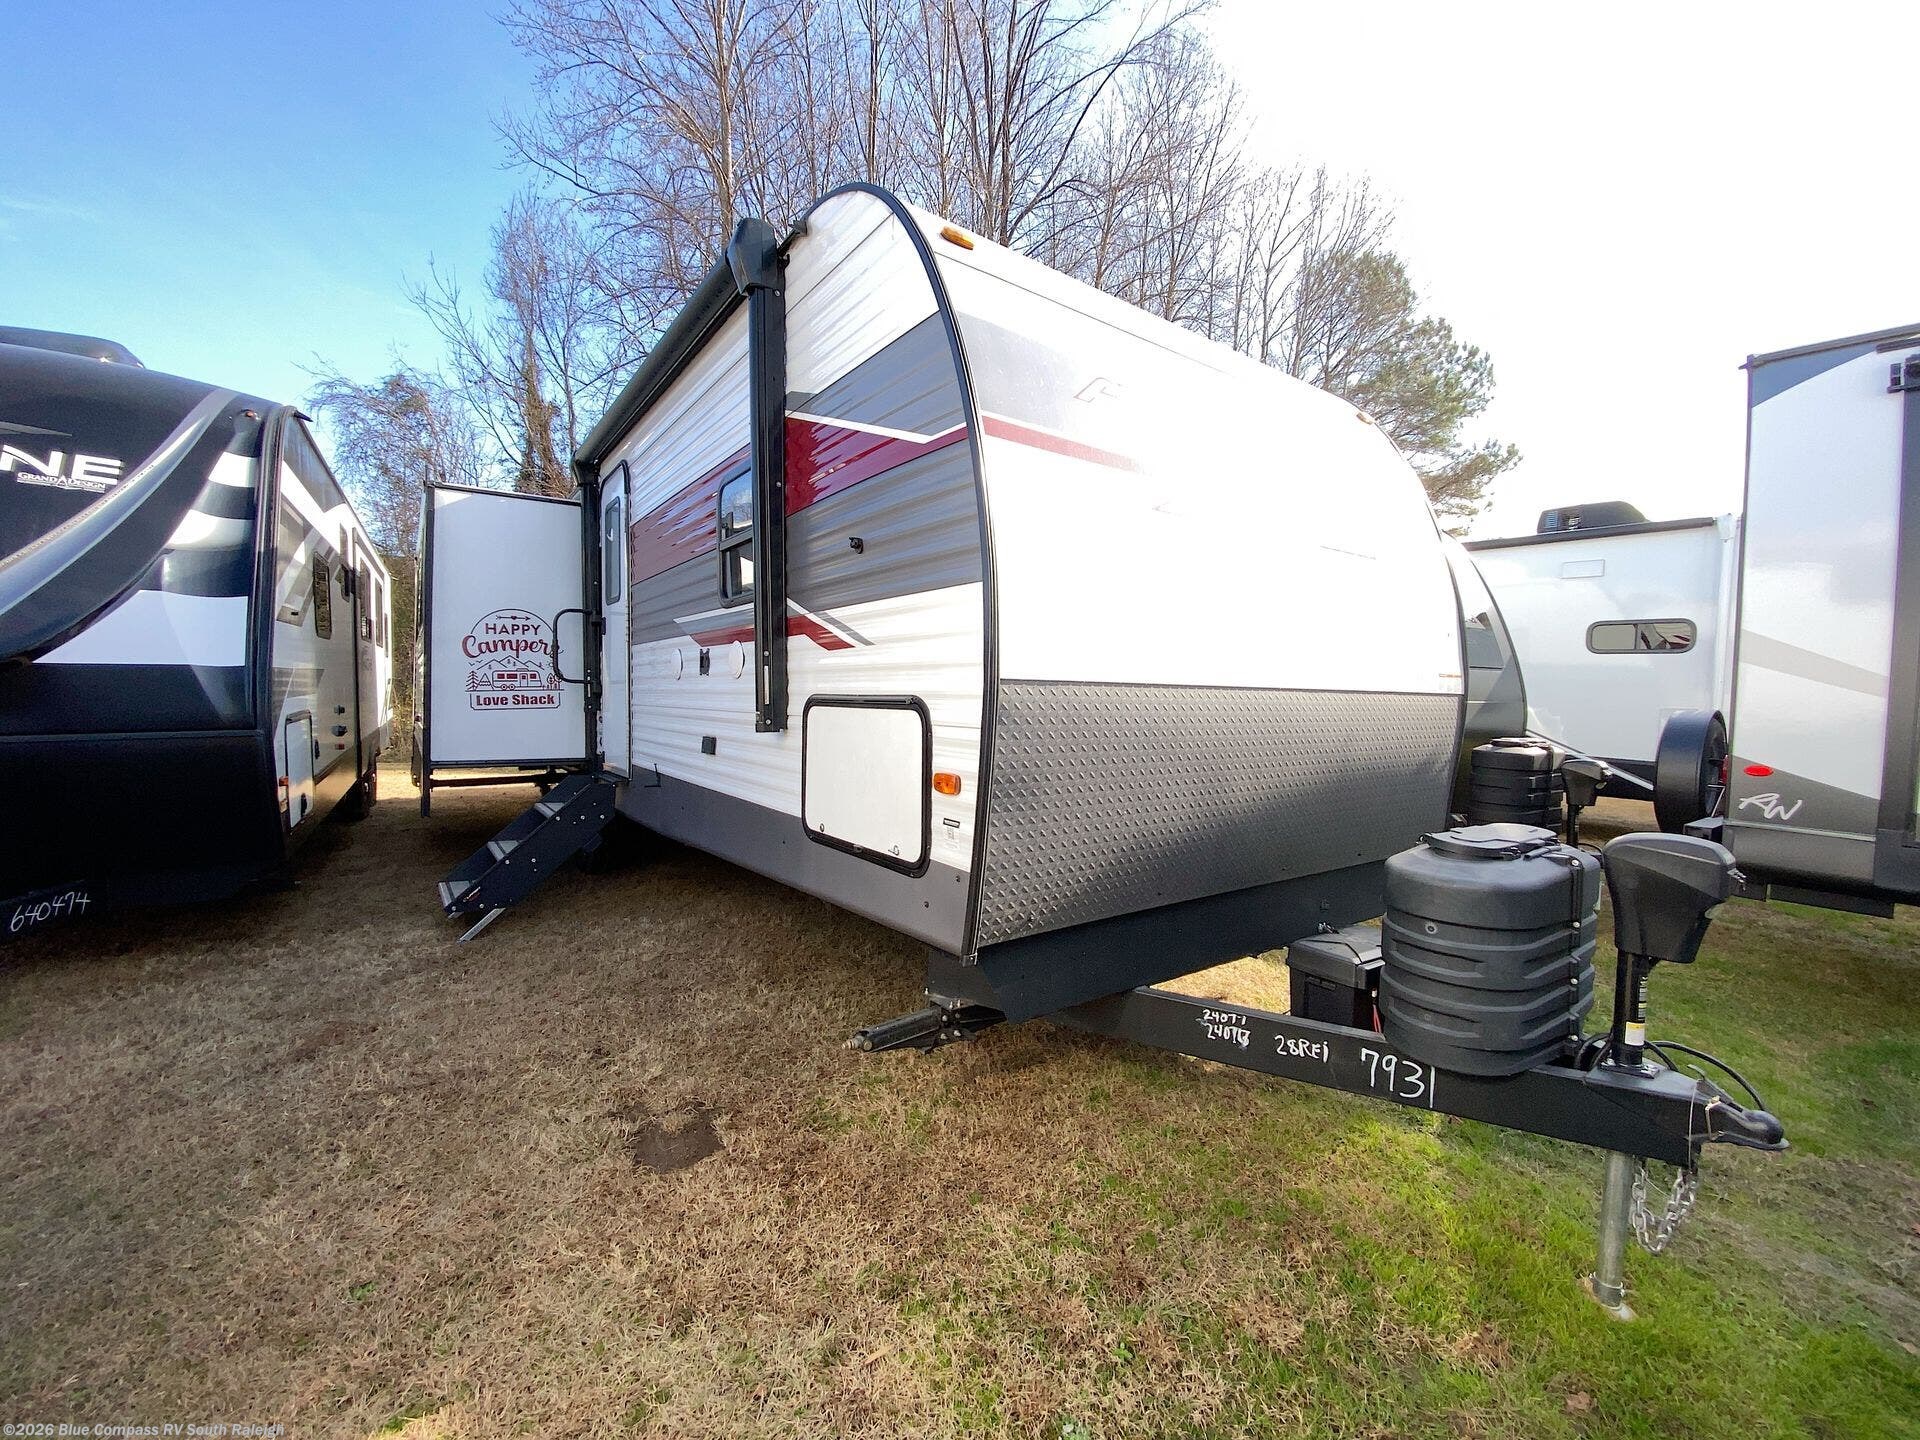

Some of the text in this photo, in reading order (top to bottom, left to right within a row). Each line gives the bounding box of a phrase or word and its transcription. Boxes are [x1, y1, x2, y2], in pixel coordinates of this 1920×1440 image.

[17, 472, 56, 484] GRAND
[485, 623, 541, 636] HAPPY
[476, 694, 555, 706] Love Shack
[10, 891, 91, 932] 640474
[1361, 1047, 1435, 1109] 7931
